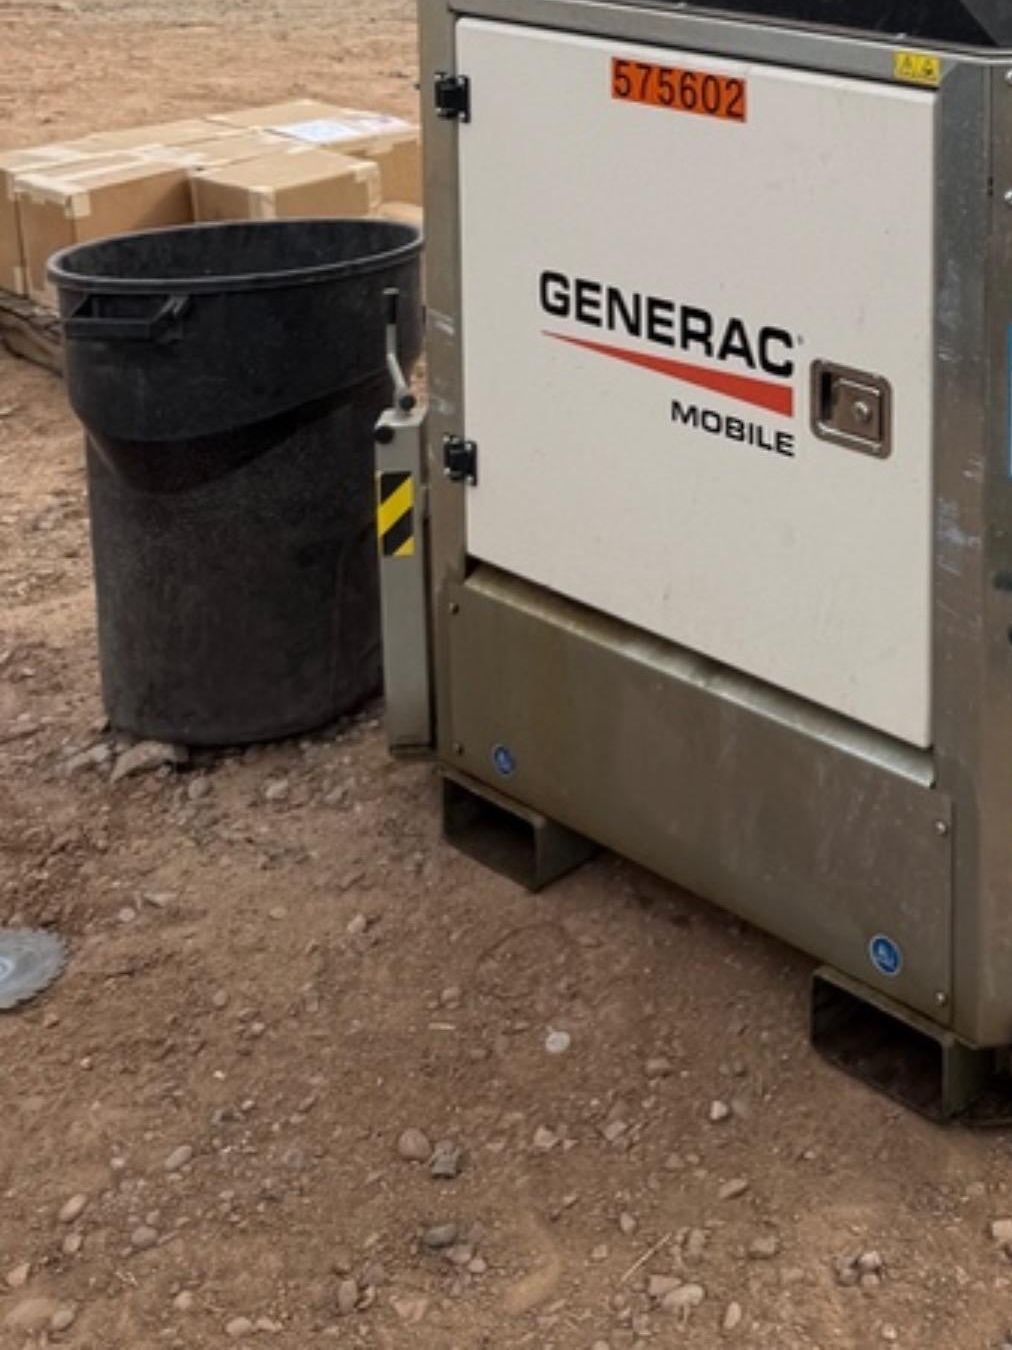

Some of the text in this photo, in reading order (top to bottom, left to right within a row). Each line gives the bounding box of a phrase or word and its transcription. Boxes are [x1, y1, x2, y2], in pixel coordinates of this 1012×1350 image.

[613, 58, 744, 120] 575602
[539, 269, 794, 379] GENERAC
[670, 399, 795, 458] MOBILE
